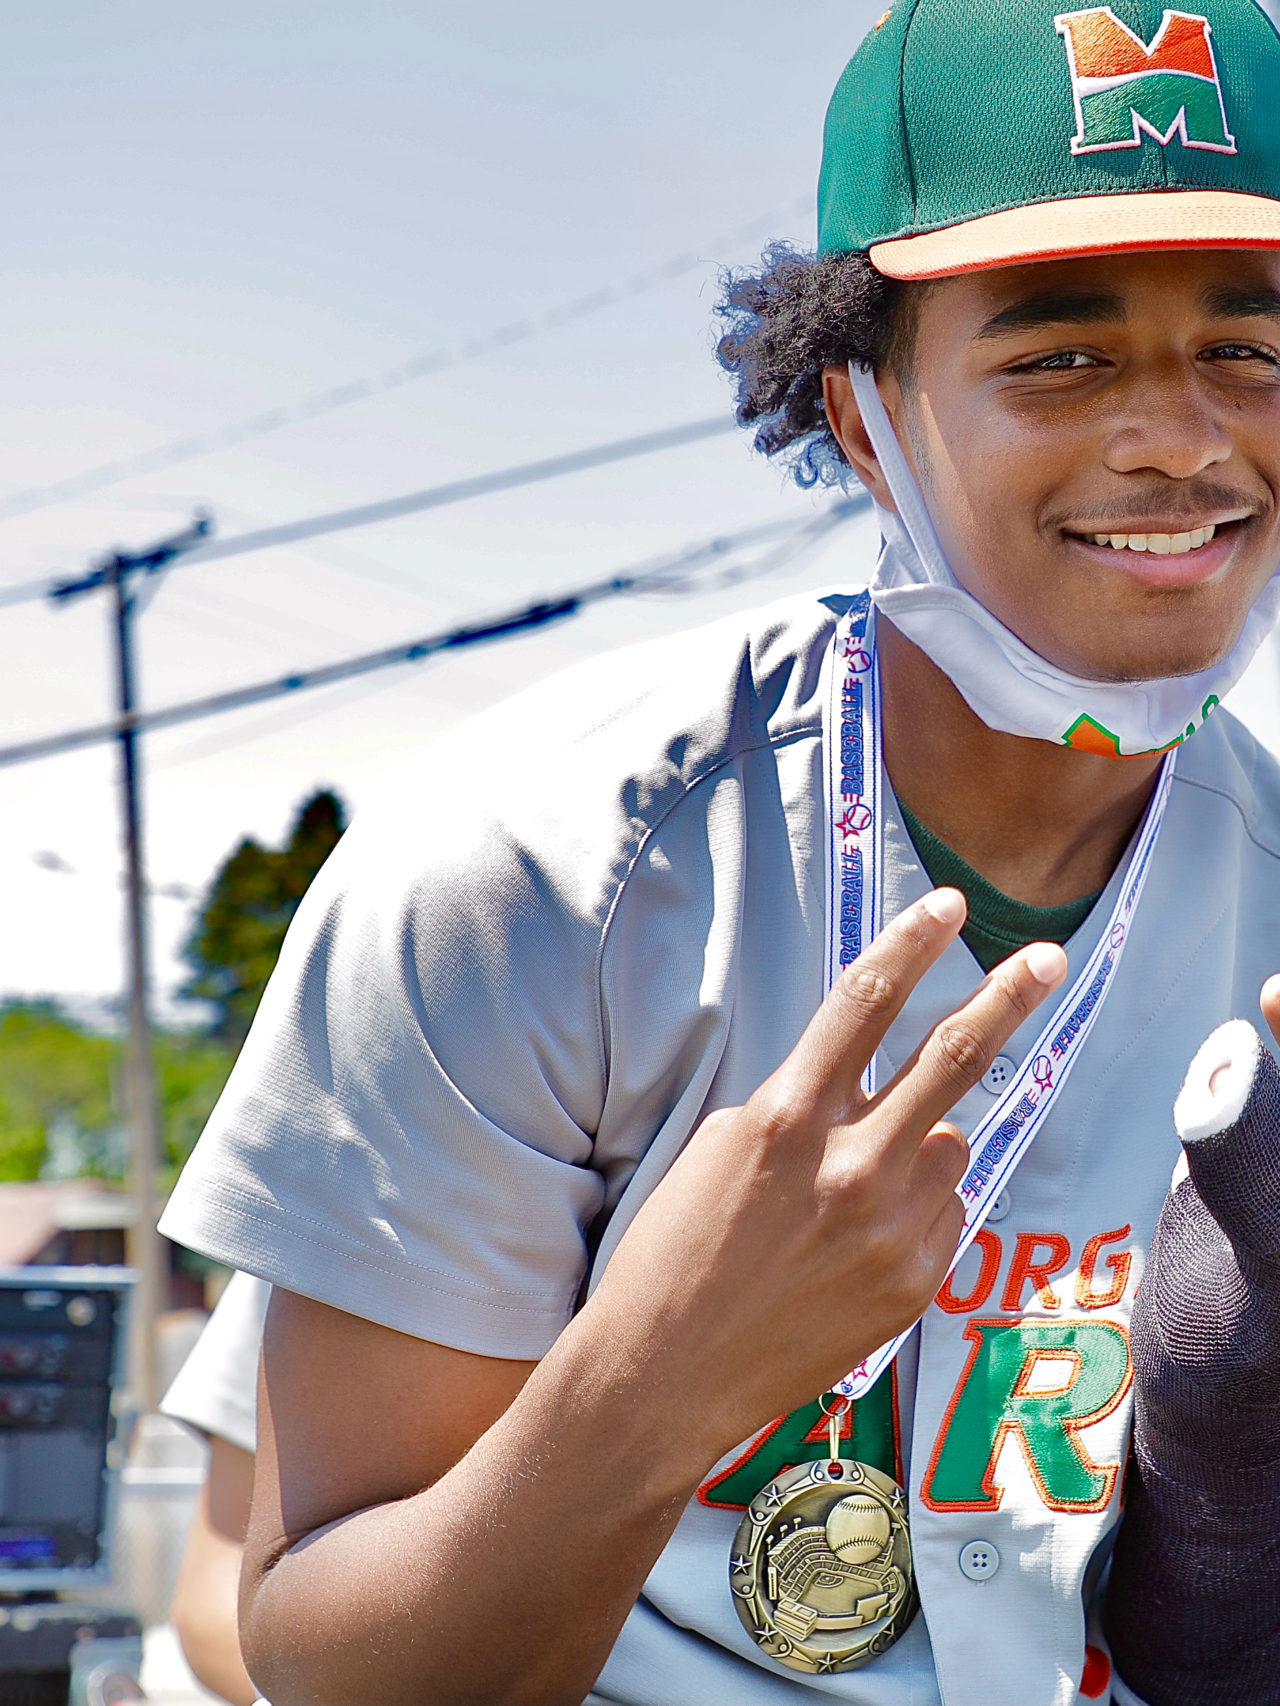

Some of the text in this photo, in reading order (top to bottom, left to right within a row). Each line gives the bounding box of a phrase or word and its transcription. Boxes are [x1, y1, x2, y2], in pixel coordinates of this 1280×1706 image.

[1053, 6, 1238, 156] M
[841, 681, 864, 796] BASEBALL
[840, 848, 862, 966] BASEBALL
[1051, 951, 1113, 1055] BASEBALL
[961, 1093, 1037, 1198] BASEBALL
[934, 1223, 1136, 1314] ORG
